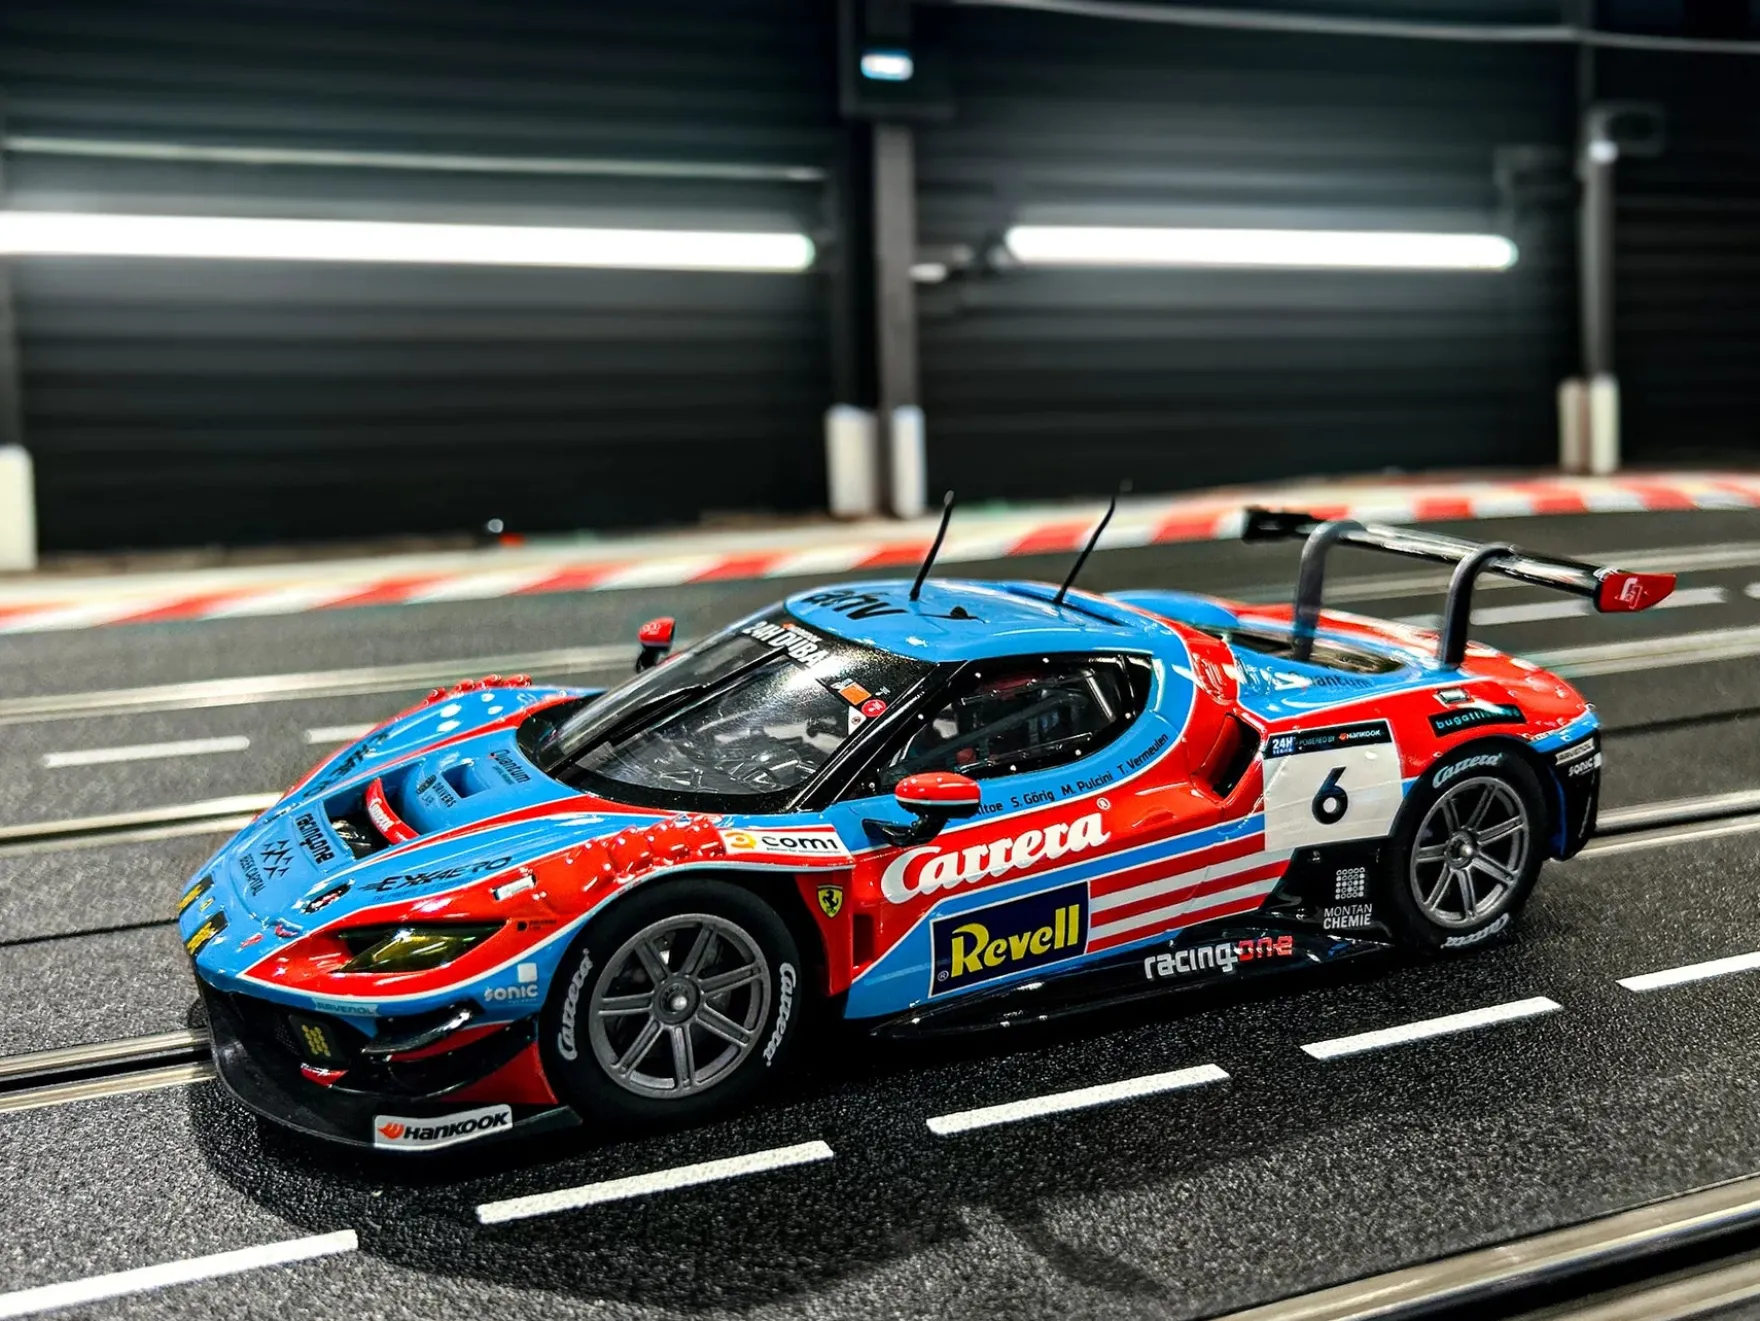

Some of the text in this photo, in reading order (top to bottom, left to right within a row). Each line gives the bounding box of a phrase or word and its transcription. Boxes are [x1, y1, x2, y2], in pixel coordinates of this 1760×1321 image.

[976, 802, 1004, 816] ltoe
[1011, 797, 1022, 808] S.
[1024, 790, 1055, 805] Görig
[1061, 785, 1075, 797] M.
[1077, 772, 1114, 792] Pulcini
[1128, 733, 1169, 770] Vermeulen
[1272, 736, 1294, 750] 24H
[1432, 752, 1503, 788] Carrera
[1312, 766, 1349, 825] 6
[881, 812, 1112, 904] Carrera
[951, 903, 1081, 978] Revell
[1323, 904, 1373, 918] MONTAN
[1323, 912, 1372, 930] CHEMIE
[557, 947, 593, 1061] Carrera
[762, 962, 797, 1067] Carrera
